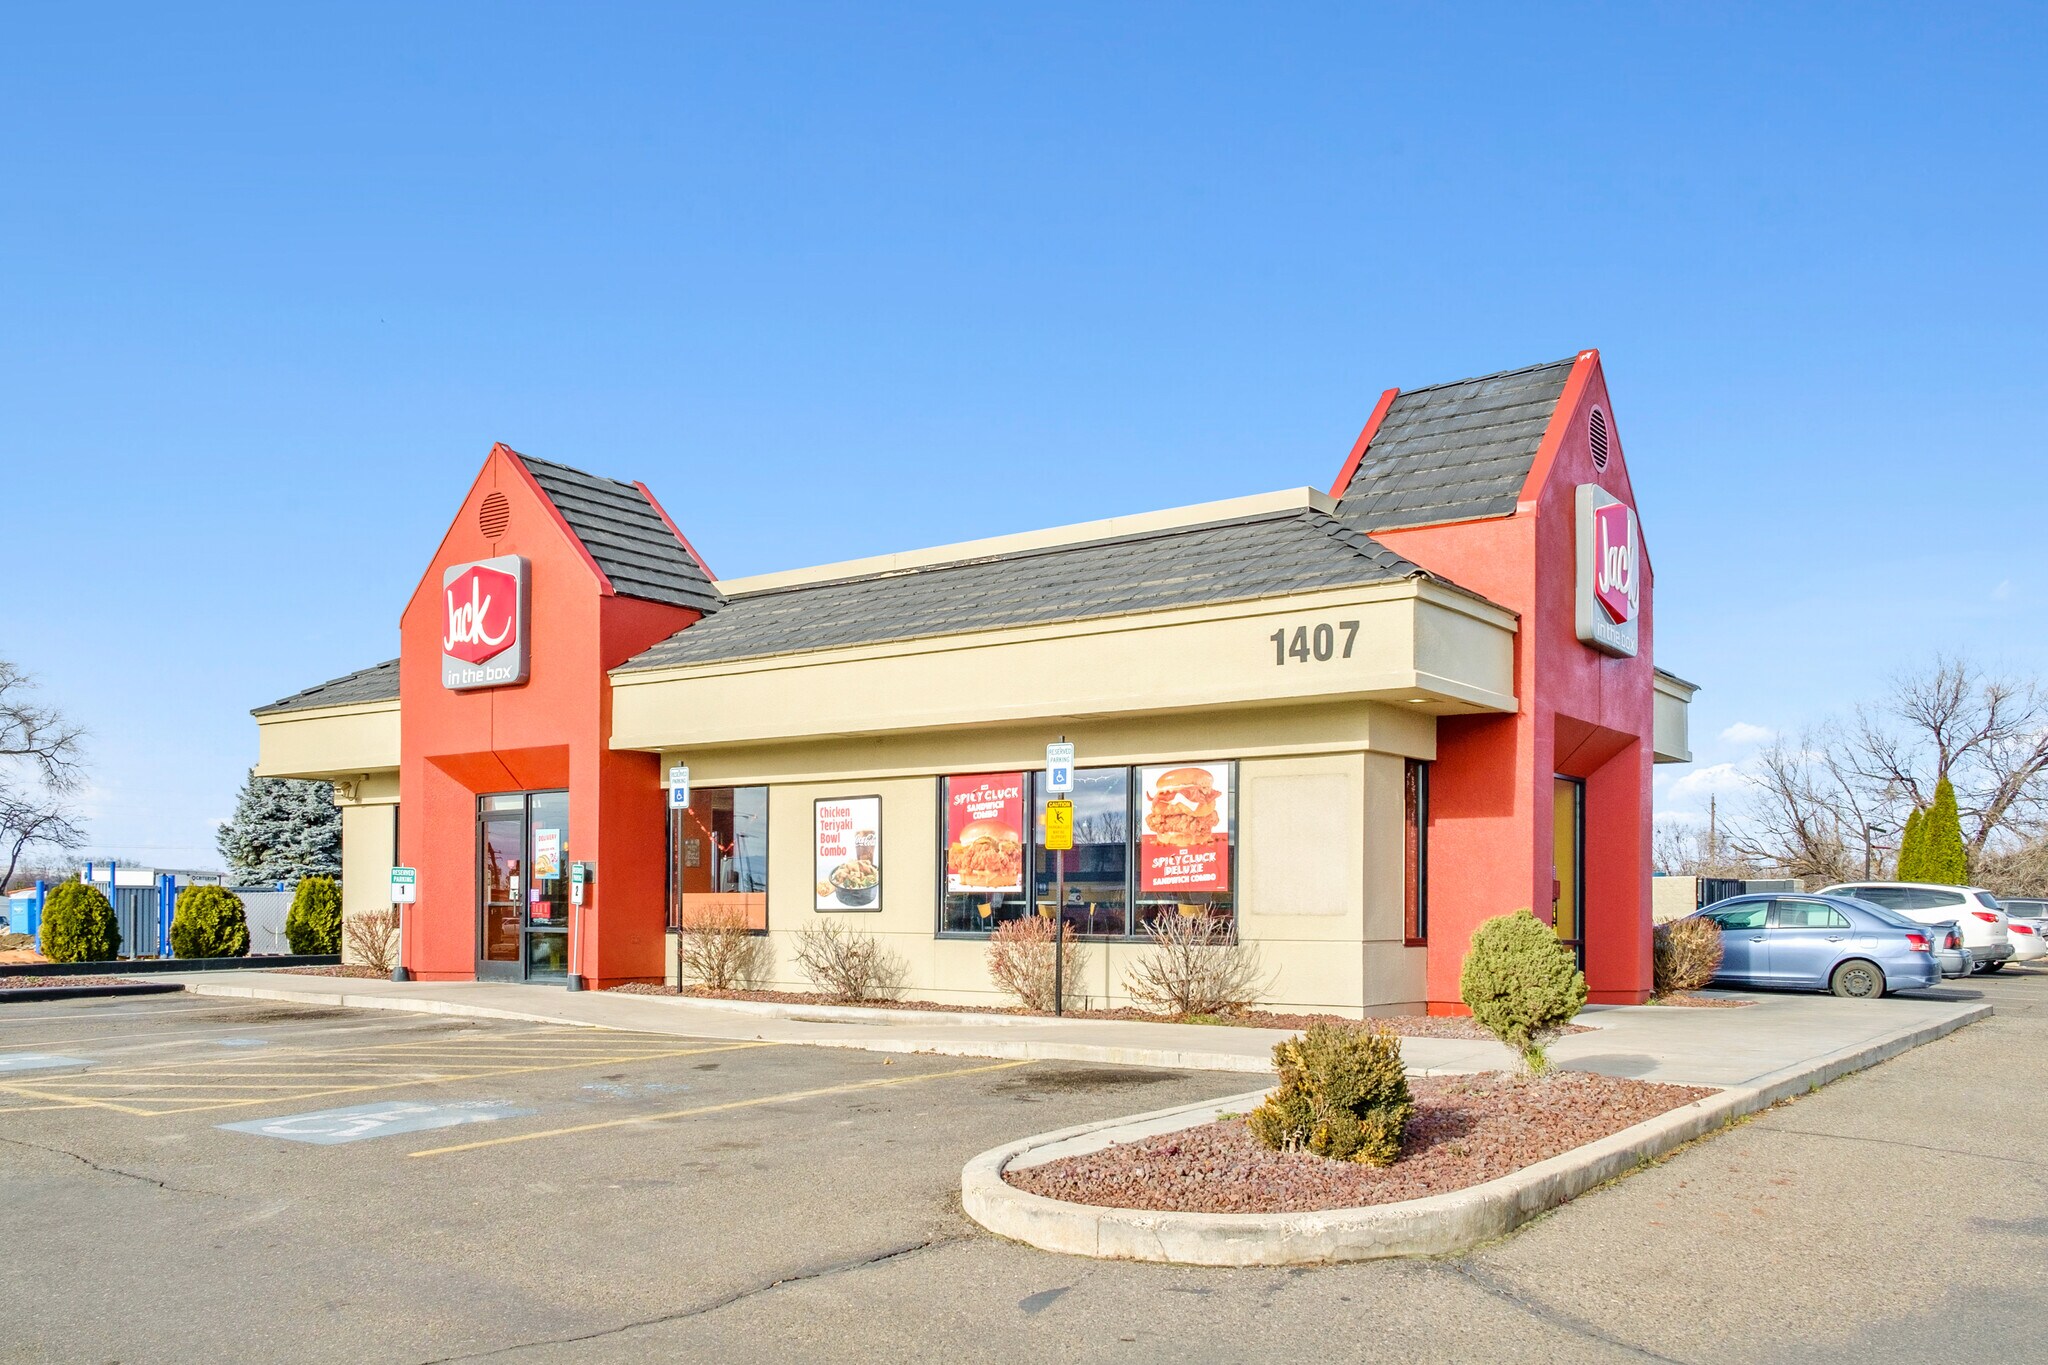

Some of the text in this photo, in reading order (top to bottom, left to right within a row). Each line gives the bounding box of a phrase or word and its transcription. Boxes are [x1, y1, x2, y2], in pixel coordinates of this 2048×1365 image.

[1599, 516, 1638, 608] Jack
[444, 576, 511, 651] Jack
[1597, 617, 1635, 651] in the box
[1270, 620, 1360, 666] 1407
[448, 665, 513, 685] in the box
[954, 787, 1018, 806] SPICY CLUCK
[820, 806, 850, 818] Chicken
[967, 800, 1004, 812] SANDWICH
[973, 810, 998, 820] COMBO
[820, 818, 853, 832] Teriyaki
[820, 832, 840, 844] Bowl
[820, 845, 847, 857] Combo
[1152, 852, 1216, 868] SPICY CLUCK
[1164, 864, 1203, 876] DELUXE
[1153, 874, 1216, 885] SANDWICH COMBO
[401, 885, 405, 895] 1
[575, 885, 579, 896] 2
